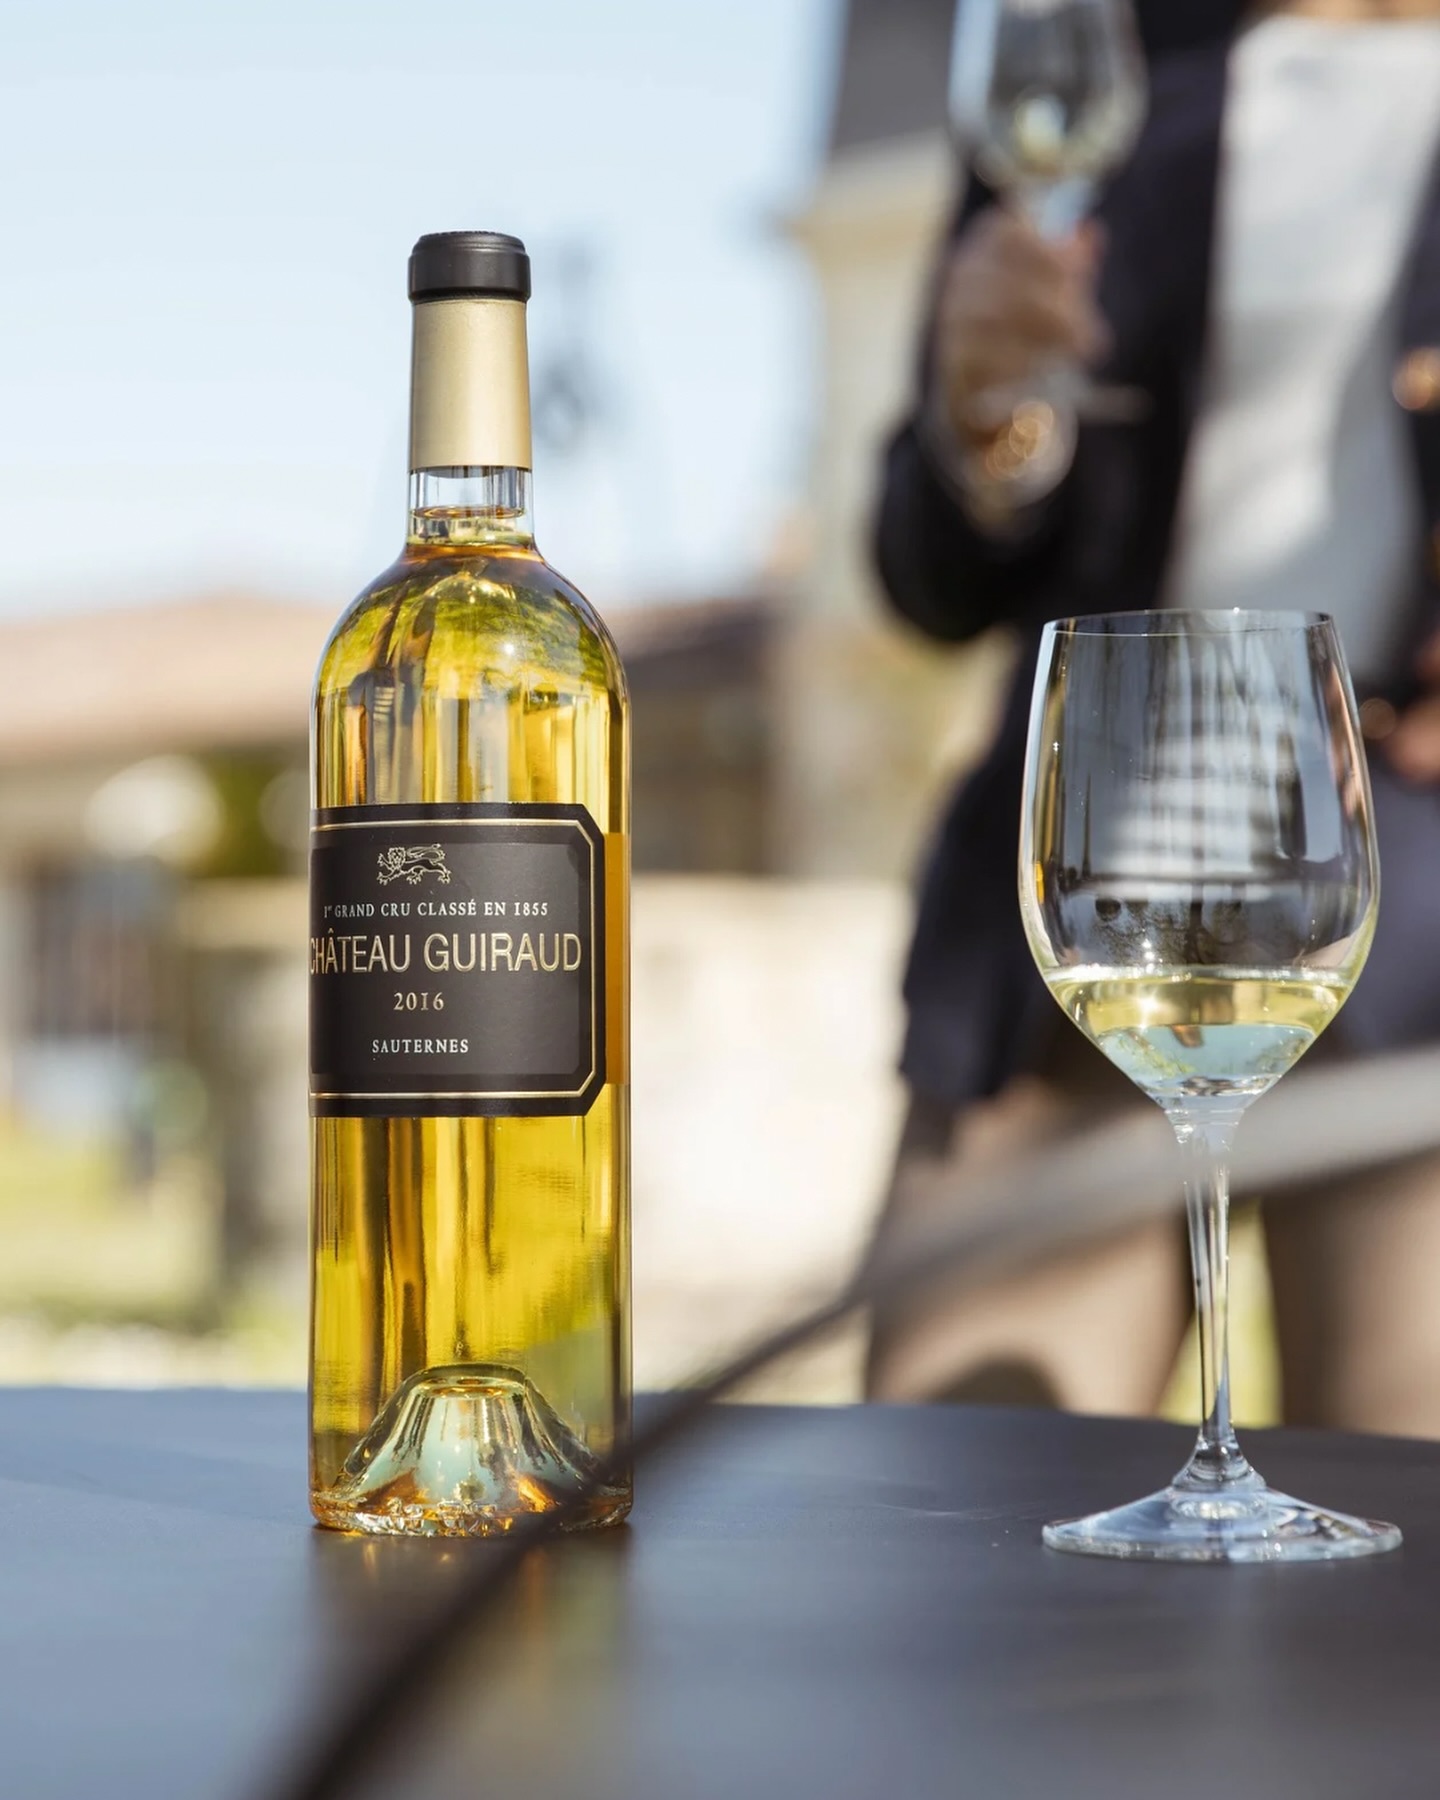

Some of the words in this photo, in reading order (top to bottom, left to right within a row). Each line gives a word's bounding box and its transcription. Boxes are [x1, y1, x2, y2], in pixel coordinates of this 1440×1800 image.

[335, 903, 375, 918] GRAND
[380, 902, 411, 917] CRU
[417, 899, 477, 917] CLASSÉ
[484, 901, 507, 916] EN
[514, 902, 549, 917] 1855
[310, 927, 411, 975] CHÂTEAU
[423, 932, 582, 974] GUIRAUD
[393, 991, 445, 1012] 2016
[372, 1038, 470, 1055] SAUTERNES
